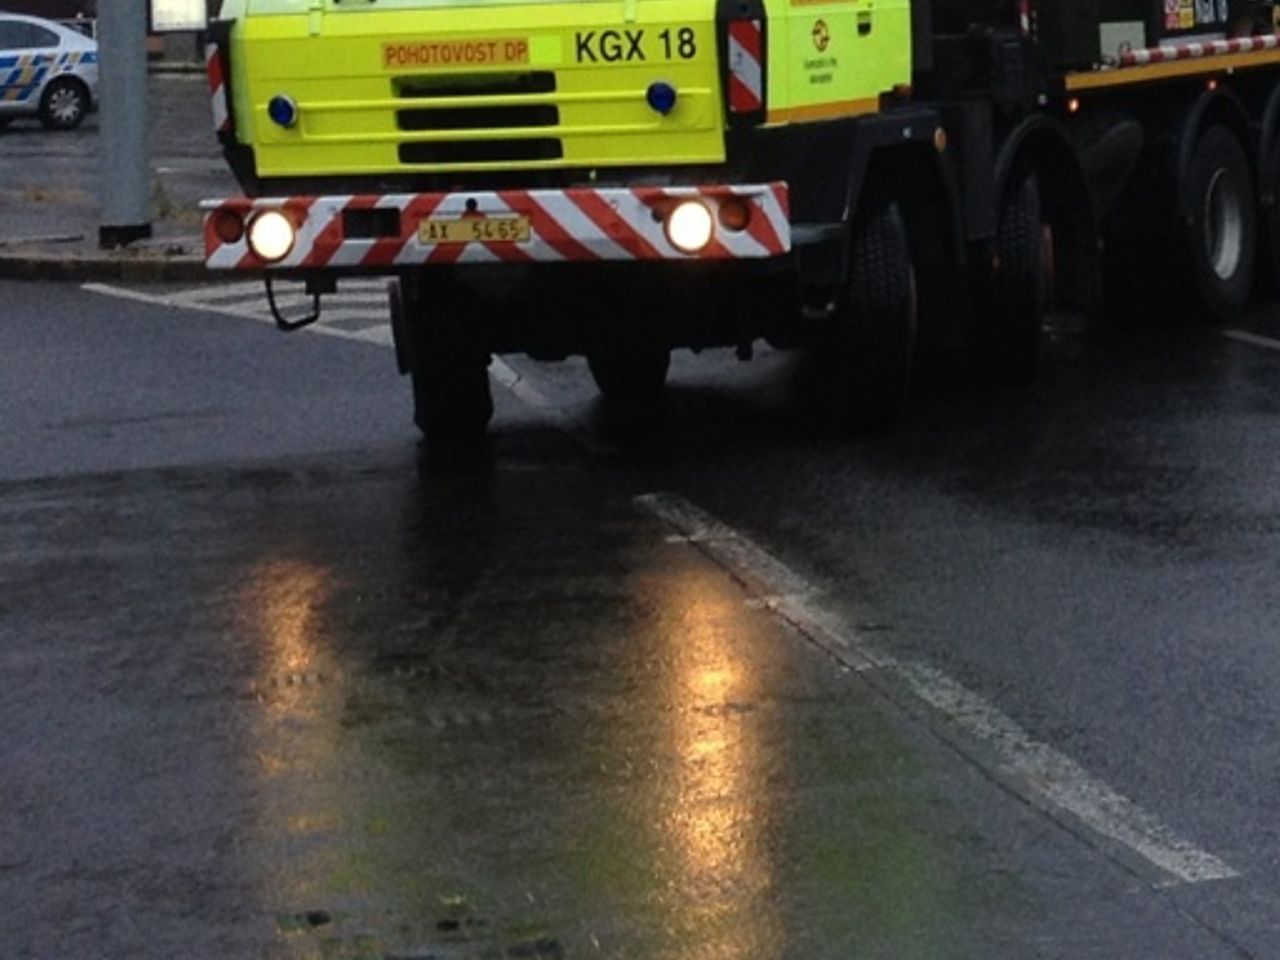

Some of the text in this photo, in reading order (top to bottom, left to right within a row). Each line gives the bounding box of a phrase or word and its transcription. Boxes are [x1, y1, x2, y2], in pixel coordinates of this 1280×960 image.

[385, 40, 528, 66] POHOTOVOST DP
[575, 27, 697, 63] KGX 18
